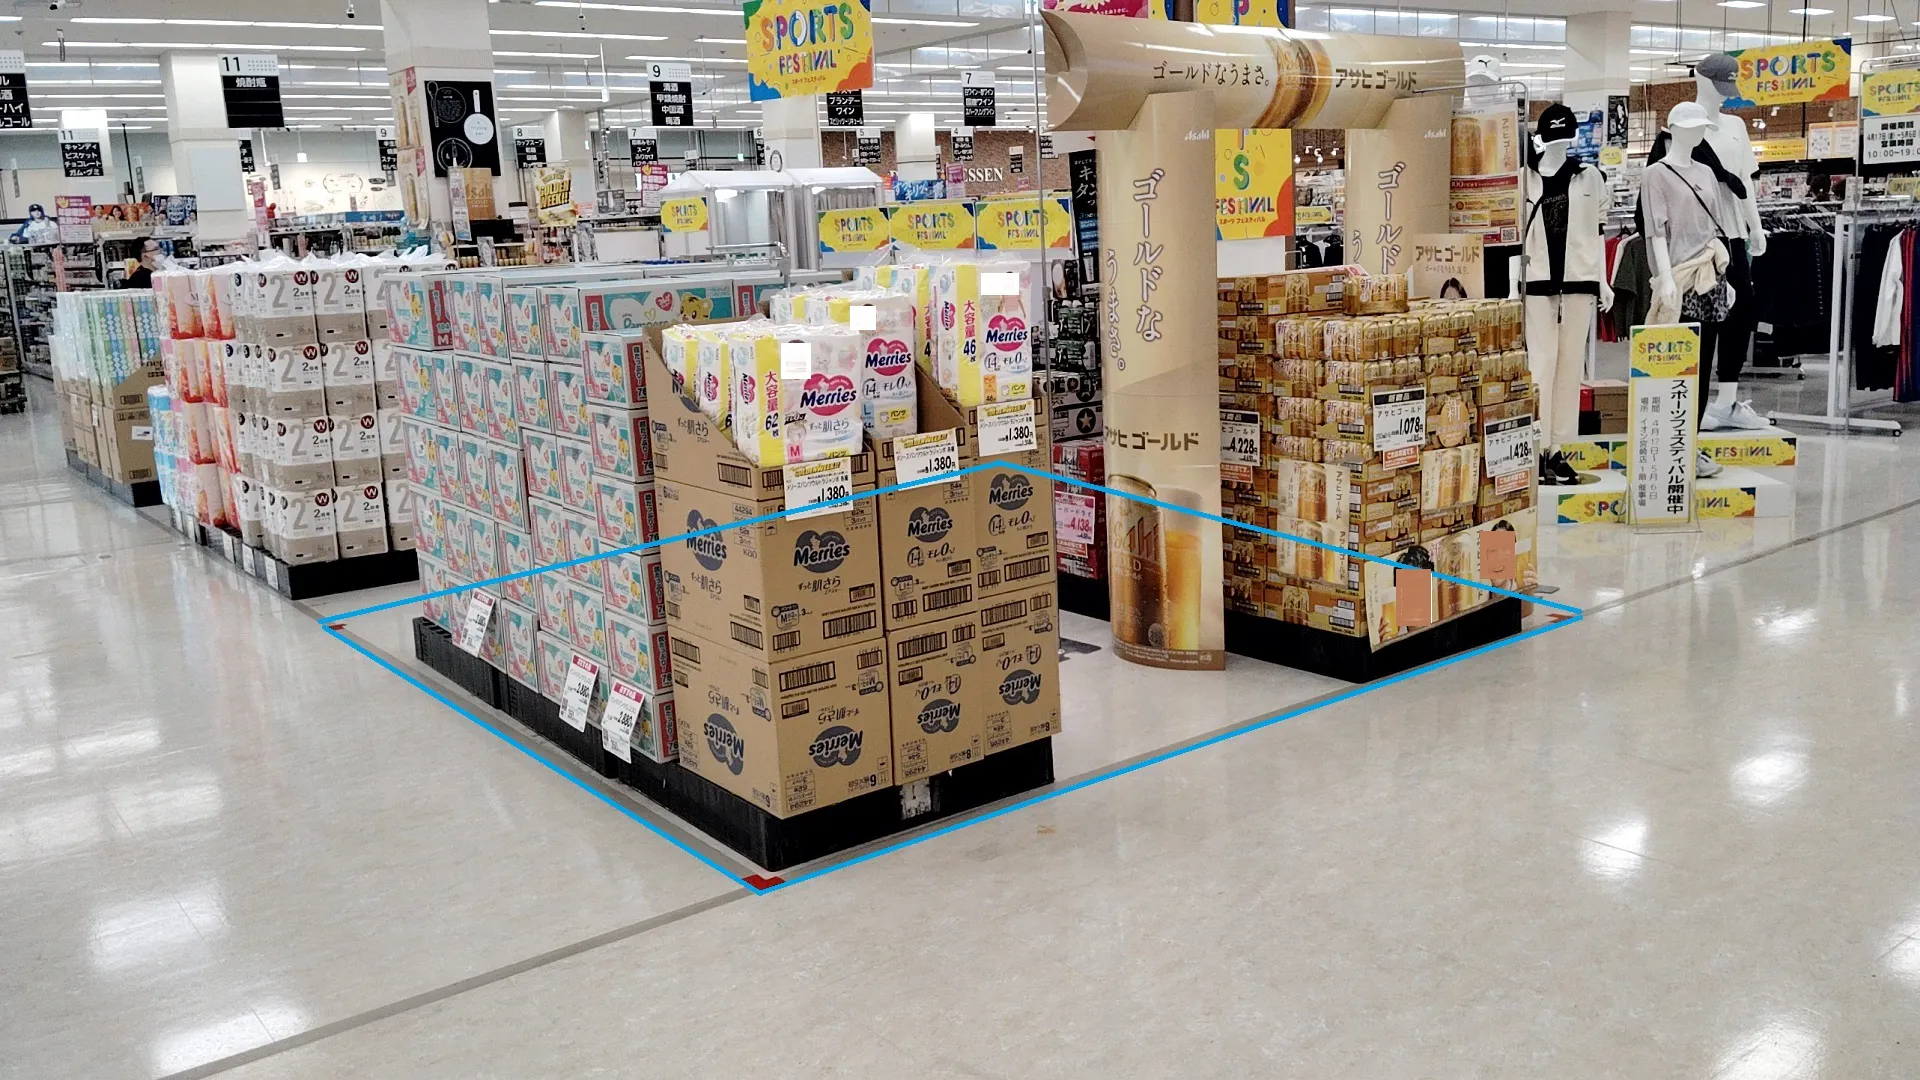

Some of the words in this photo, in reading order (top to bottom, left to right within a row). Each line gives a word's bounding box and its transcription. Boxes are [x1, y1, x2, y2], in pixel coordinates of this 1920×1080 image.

[760, 3, 854, 52] SPORTS
[222, 57, 240, 71] 11
[653, 65, 661, 77] 9
[779, 49, 837, 76] FESTIVAL
[1740, 50, 1835, 80] SPORTS
[966, 73, 971, 84] 7
[1153, 61, 1269, 86] ゴールドなうまさ。
[1757, 77, 1817, 92] FESTIVAL
[829, 97, 860, 105] ブランデー
[836, 107, 855, 115] ワイン
[61, 130, 73, 140] 11
[380, 129, 387, 137] 9
[516, 129, 523, 137] 8
[632, 128, 637, 137] 7
[1184, 129, 1210, 141] Asahi
[65, 151, 98, 159] ビスケット
[64, 160, 101, 168] チョコレート
[834, 216, 874, 232] SPORTS
[908, 212, 954, 229] SPORTS
[998, 209, 1048, 227] SPORTS
[1133, 168, 1165, 341] ゴールドな
[295, 272, 306, 283] W
[346, 271, 357, 281] W
[270, 275, 288, 308] 2
[322, 273, 339, 304] 2
[1105, 249, 1126, 371] うまさ。
[963, 300, 976, 338] 大容量
[986, 328, 1028, 344] Merries
[305, 347, 316, 358] W
[356, 343, 367, 352] W
[963, 339, 976, 355] 46
[1639, 340, 1692, 354] SPORTS
[279, 350, 297, 382] 2
[332, 345, 348, 377] 2
[865, 351, 911, 368] Merries
[765, 371, 778, 412] 大容量
[800, 388, 856, 408] Merries
[863, 404, 871, 415] L
[1651, 396, 1660, 413] 期間
[314, 421, 326, 431] W
[362, 417, 373, 427] W
[765, 413, 779, 431] 62
[809, 418, 849, 433] ずっと肌さら
[289, 425, 307, 456] 2
[337, 420, 354, 451] 2
[789, 445, 800, 457] M
[1667, 379, 1688, 514] スポーツフェスティバル開催中
[1715, 446, 1772, 460] FESTIVAL
[316, 494, 328, 505] W
[365, 487, 377, 497] W
[989, 484, 1033, 504] Merries
[291, 498, 308, 529] 2
[340, 491, 358, 522] 2
[907, 518, 953, 538] Merries
[686, 530, 727, 559] Merries
[793, 543, 851, 567] Merries
[691, 572, 722, 595] ずっと肌さら
[798, 576, 841, 592] ずっと肌さら
[999, 673, 1042, 695] Merries
[917, 703, 961, 724] Merries
[704, 722, 744, 759] Merries
[809, 730, 863, 756] Merries
